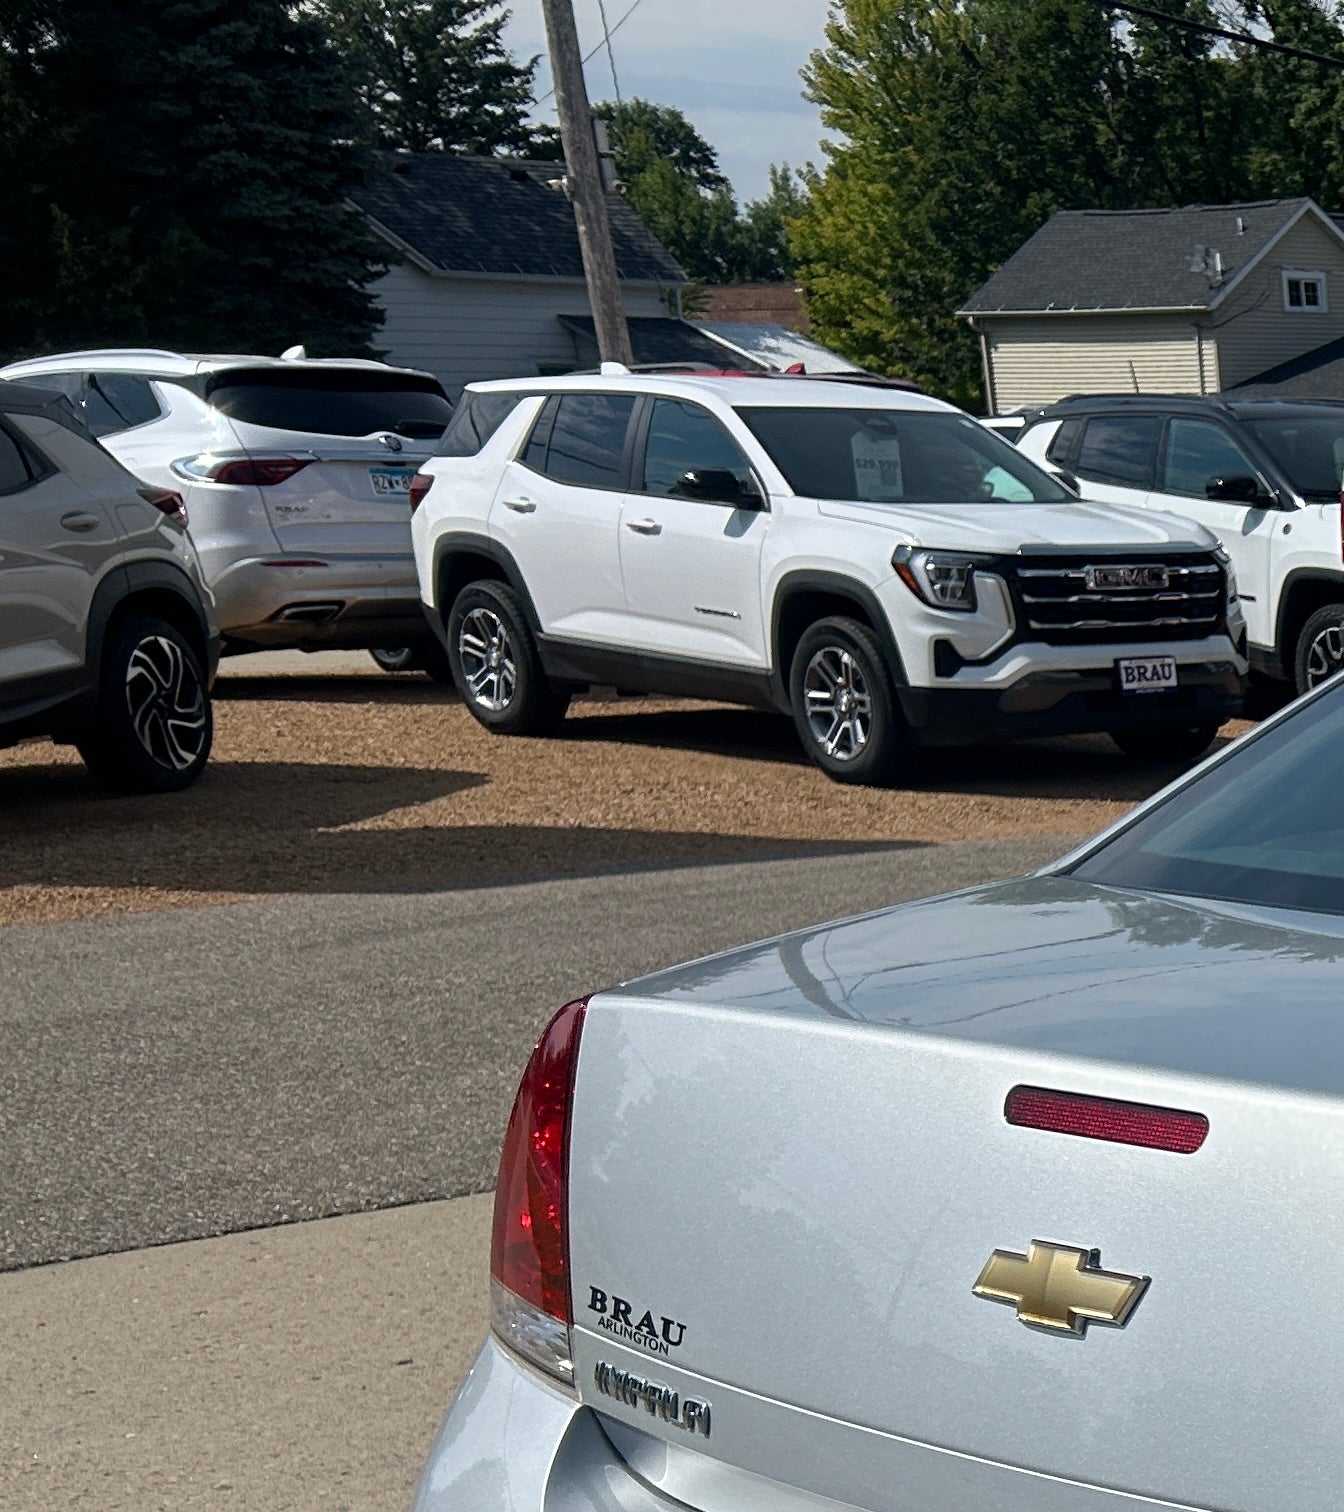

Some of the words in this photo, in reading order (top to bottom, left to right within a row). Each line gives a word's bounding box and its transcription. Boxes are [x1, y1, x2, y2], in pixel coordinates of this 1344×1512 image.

[1096, 569, 1161, 587] GMC
[1124, 664, 1172, 683] BRAU
[587, 1285, 687, 1347] BRAU
[597, 1315, 669, 1356] ARLINGTON
